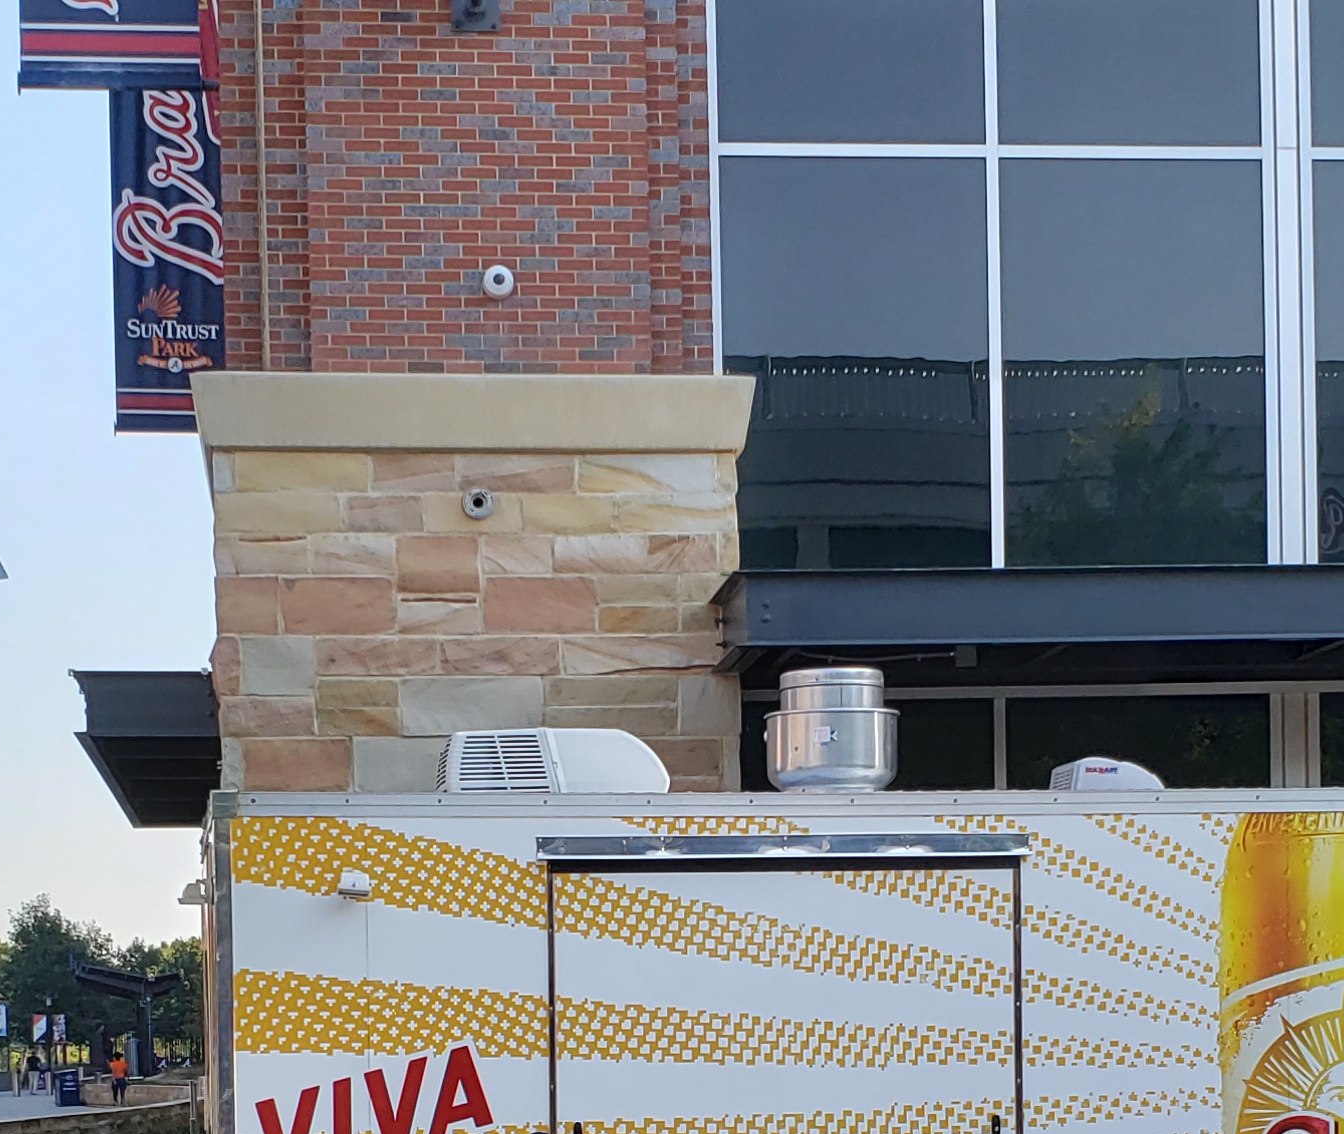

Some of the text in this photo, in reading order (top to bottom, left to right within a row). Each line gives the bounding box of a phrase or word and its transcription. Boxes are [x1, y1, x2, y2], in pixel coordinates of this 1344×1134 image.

[112, 89, 225, 286] Bra
[126, 318, 220, 341] SUNTRUST
[151, 336, 199, 358] PARK
